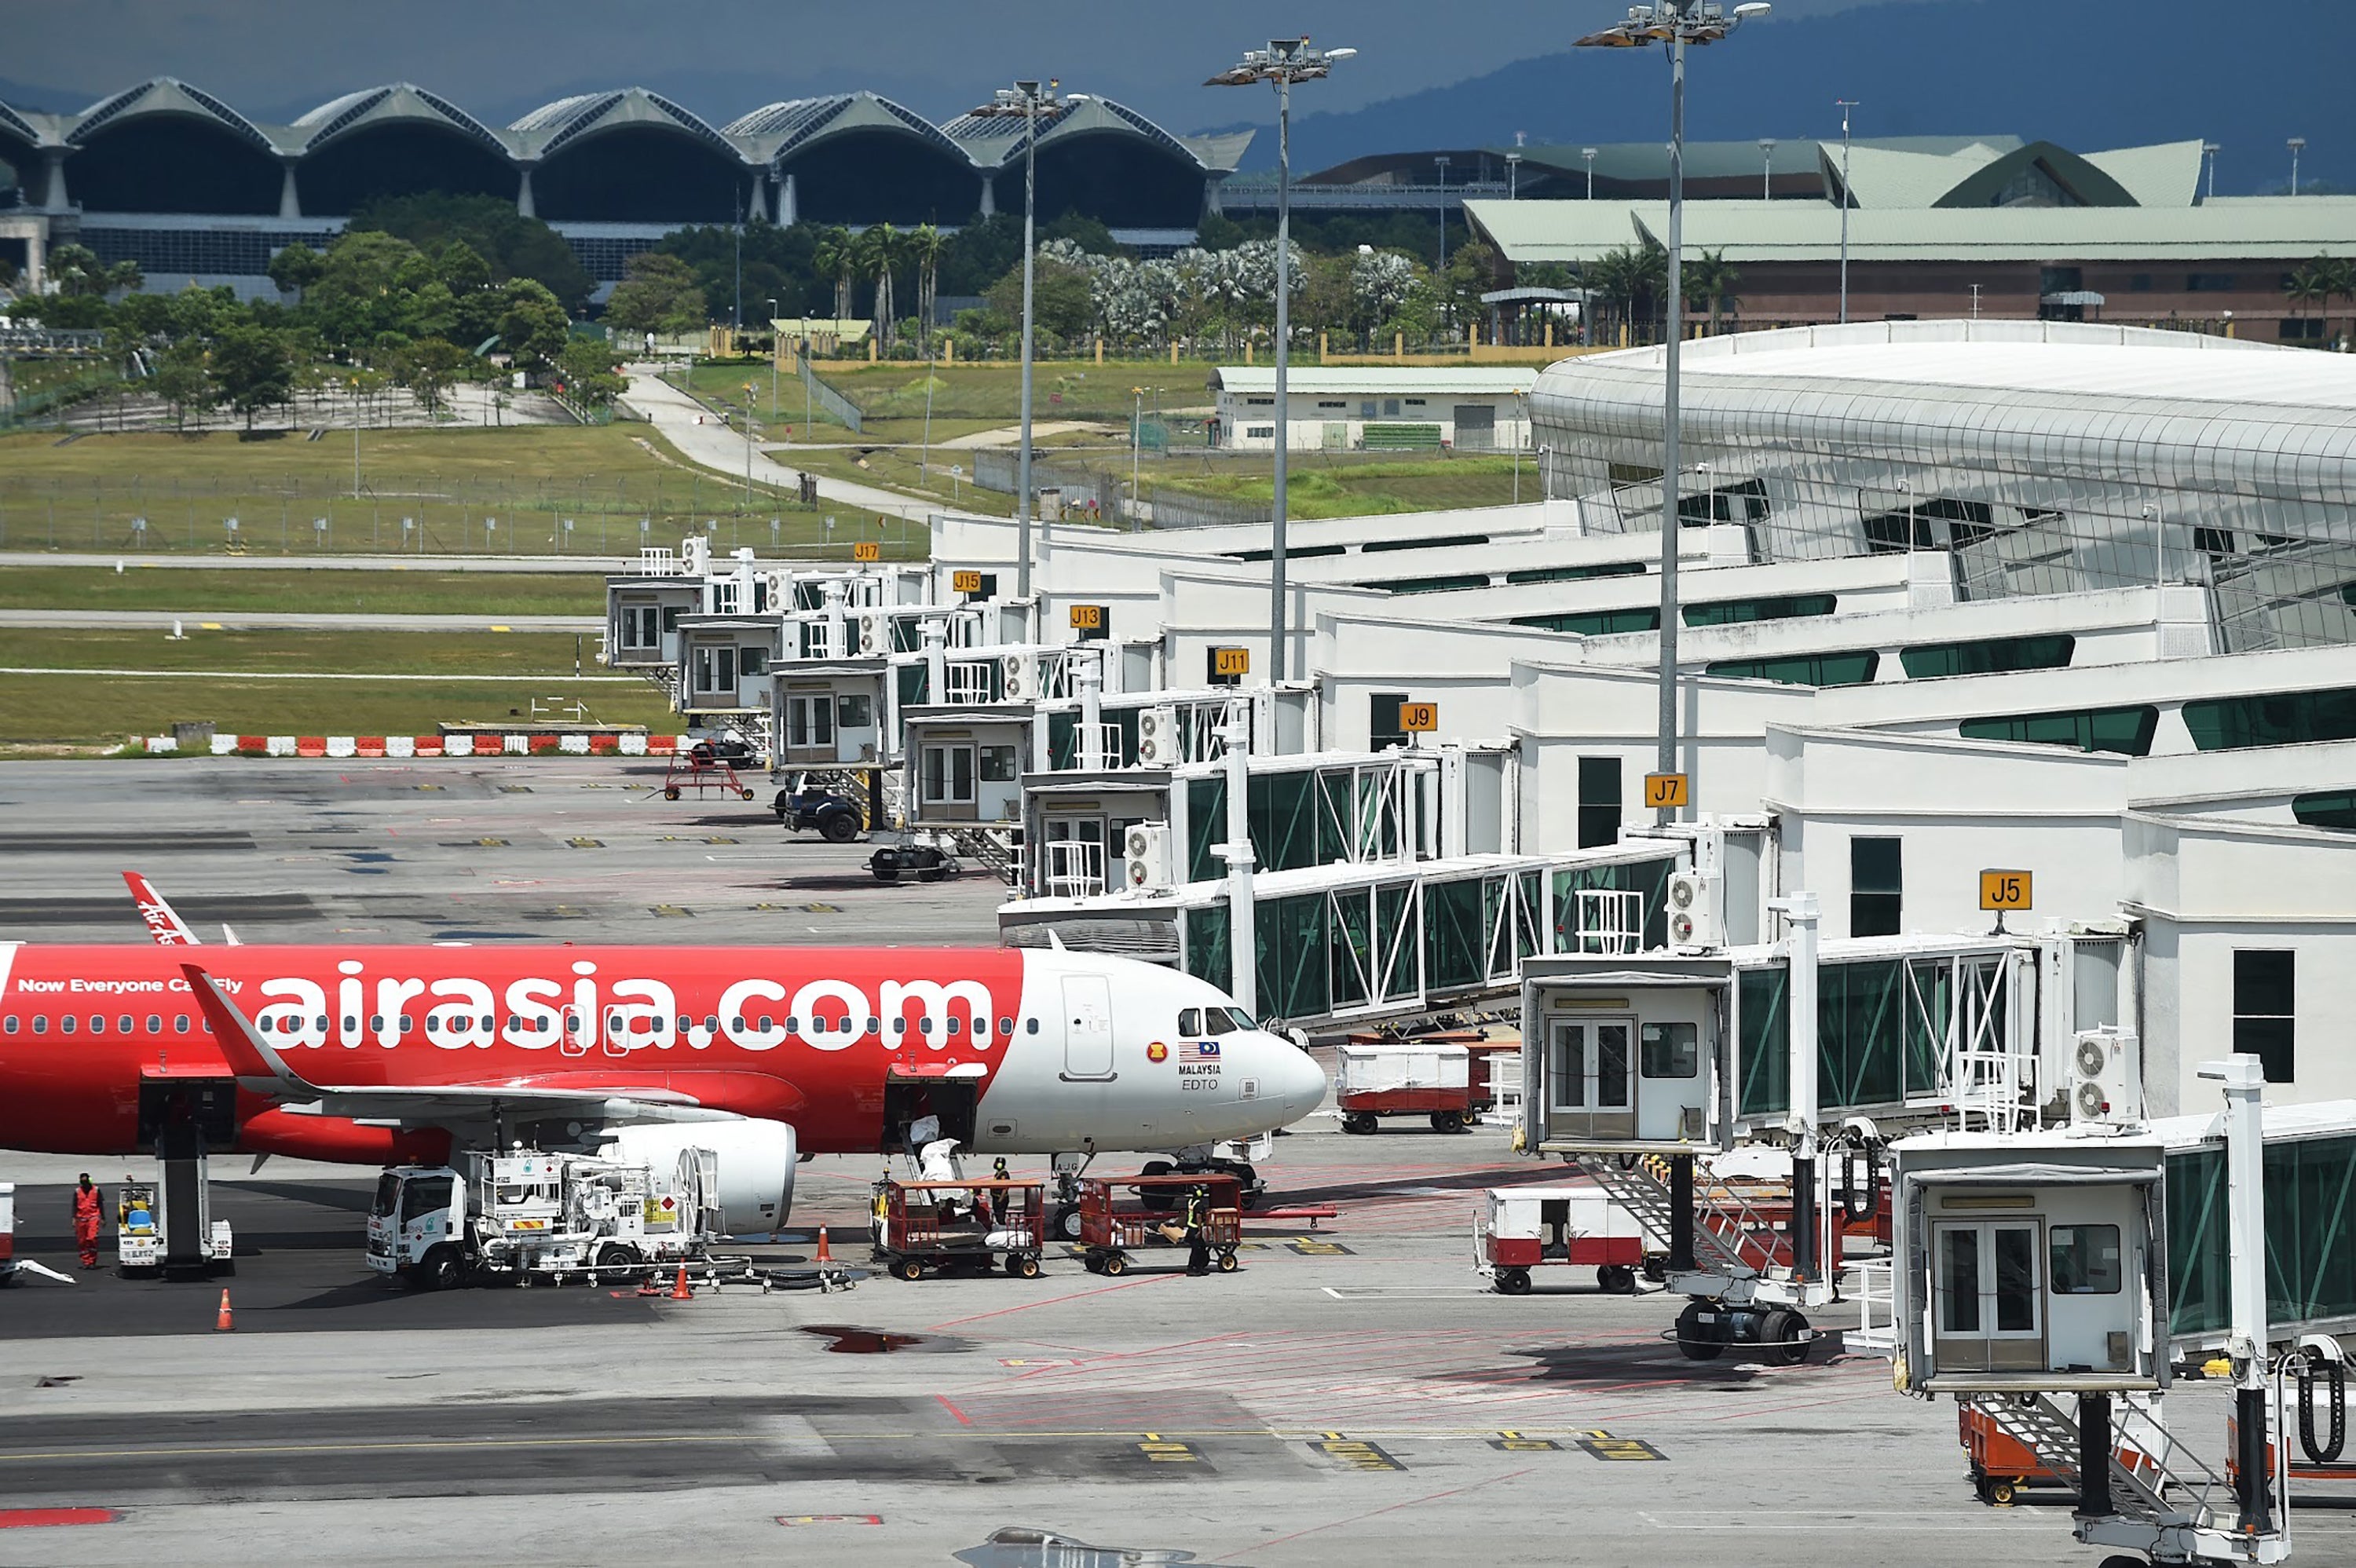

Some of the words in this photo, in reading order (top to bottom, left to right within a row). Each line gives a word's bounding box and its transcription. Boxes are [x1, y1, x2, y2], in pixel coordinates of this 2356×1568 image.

[857, 546, 877, 558] J17
[956, 574, 979, 589] J15
[1073, 609, 1099, 625] J13
[1220, 653, 1247, 671] J11
[1408, 707, 1429, 727] J9
[1655, 780, 1677, 801] J7
[1992, 879, 2020, 902] J5
[18, 979, 65, 992] Now
[71, 979, 163, 994] Everyone
[168, 978, 193, 992] Ca
[259, 960, 993, 1051] airasia.com
[1178, 1064, 1221, 1076] MALAYSIA
[1182, 1079, 1218, 1091] EDTO
[1056, 1162, 1079, 1171] AJG
